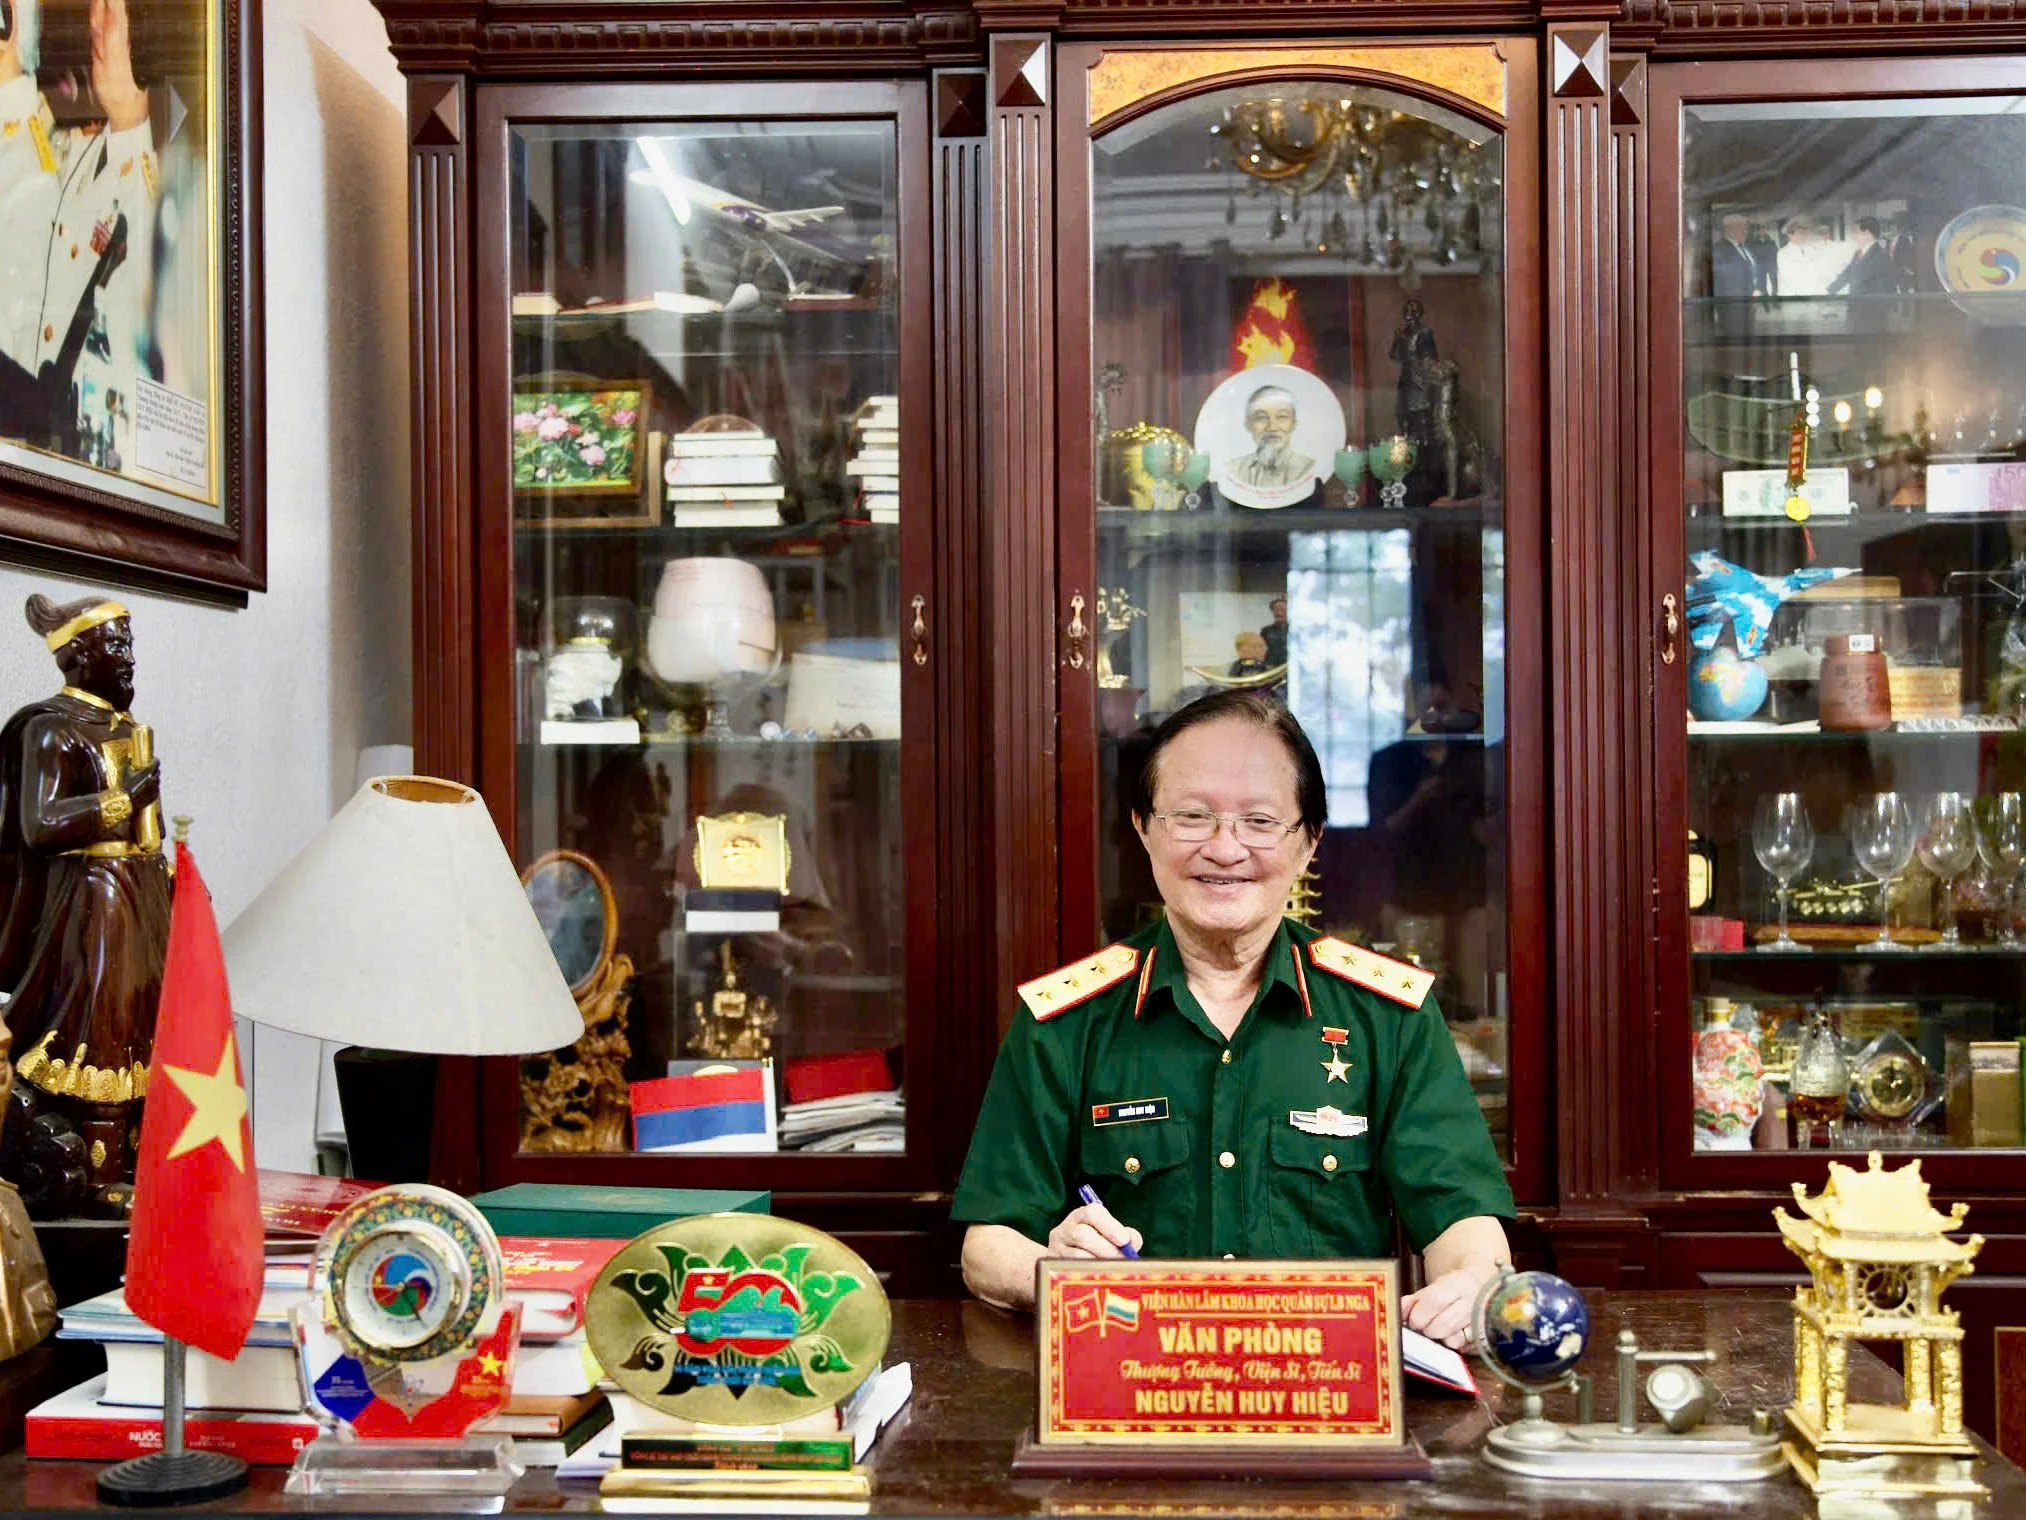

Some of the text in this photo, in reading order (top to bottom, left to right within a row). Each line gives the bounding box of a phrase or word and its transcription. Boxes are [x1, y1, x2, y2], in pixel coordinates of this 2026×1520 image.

[1222, 1294, 1255, 1310] KHOA
[1256, 1294, 1280, 1312] HỌC
[1281, 1290, 1313, 1312] QUÂN
[1346, 1295, 1370, 1311] NGA
[1158, 1321, 1322, 1354] VĂN PHÒNG
[1135, 1382, 1349, 1419] NGUYỄN HUY HIỆU
